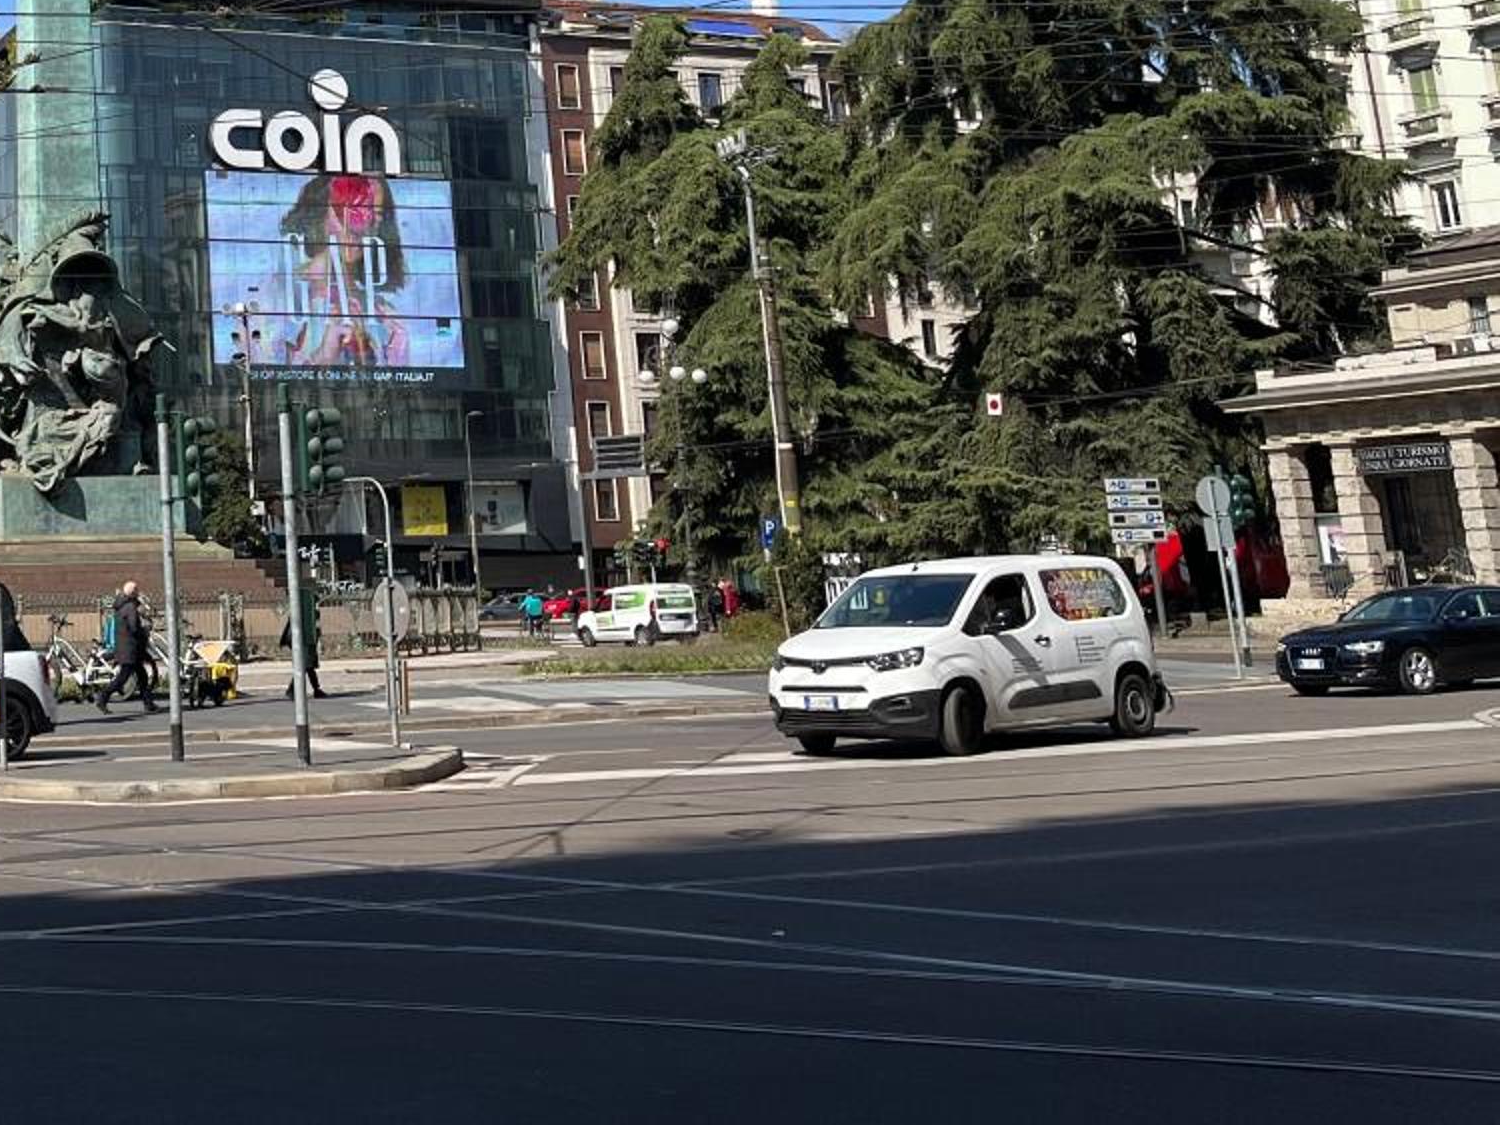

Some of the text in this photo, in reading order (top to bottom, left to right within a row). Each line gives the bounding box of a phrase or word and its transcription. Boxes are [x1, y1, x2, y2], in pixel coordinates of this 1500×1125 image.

[211, 68, 401, 175] coin
[283, 232, 388, 325] GAP
[1396, 446, 1445, 458] TURISMO
[765, 520, 775, 535] P
